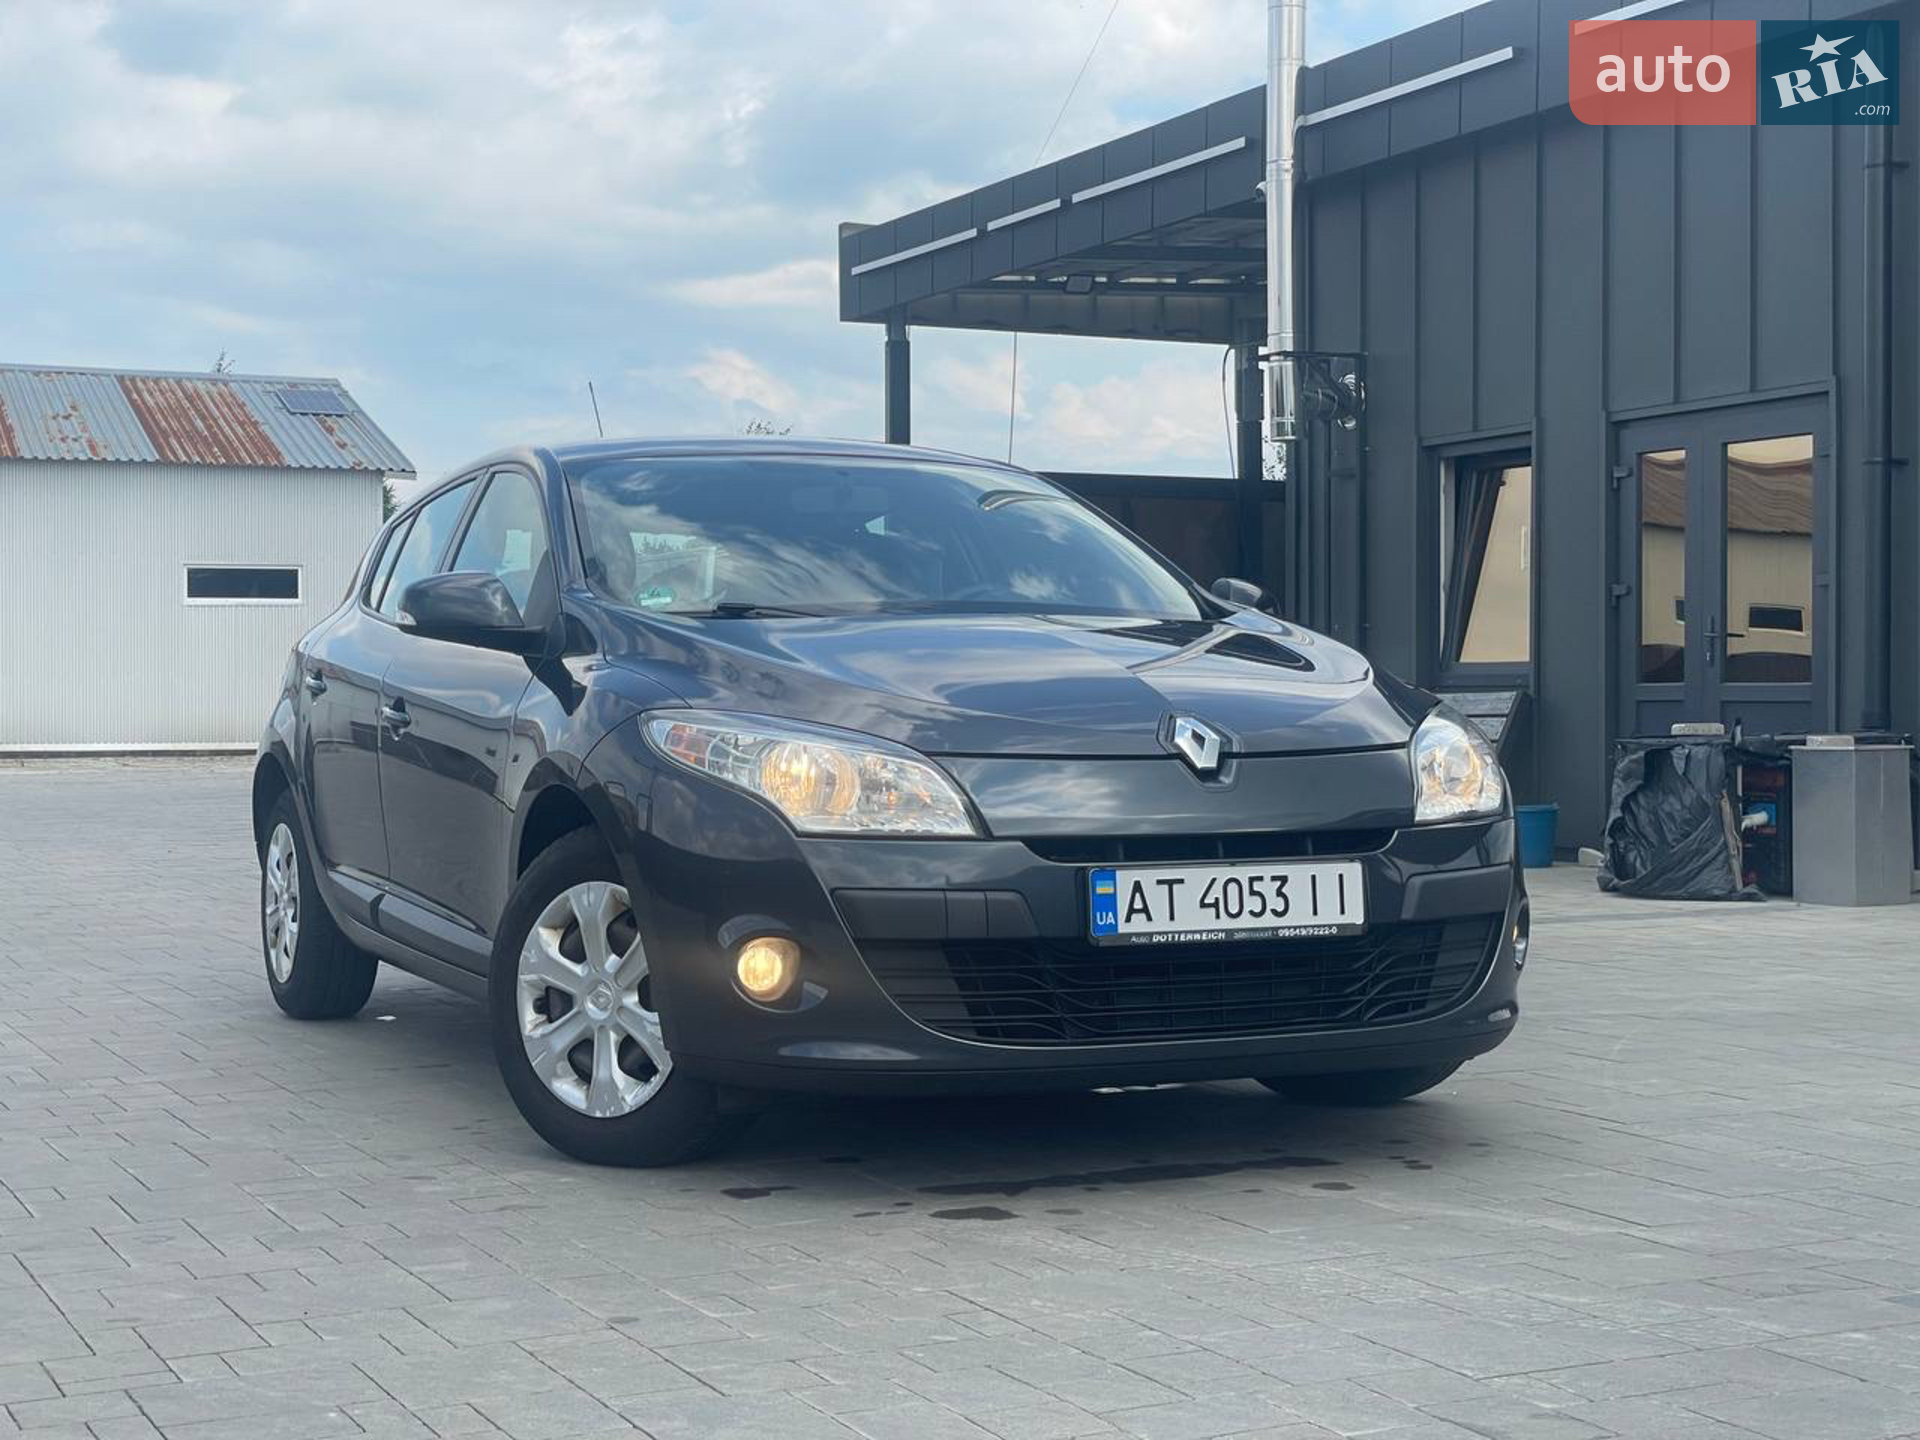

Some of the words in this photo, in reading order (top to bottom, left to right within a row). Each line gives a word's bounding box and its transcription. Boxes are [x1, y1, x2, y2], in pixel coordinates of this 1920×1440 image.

[1124, 878, 1185, 923] AT
[1199, 874, 1290, 920] 4053
[1096, 911, 1116, 925] UA
